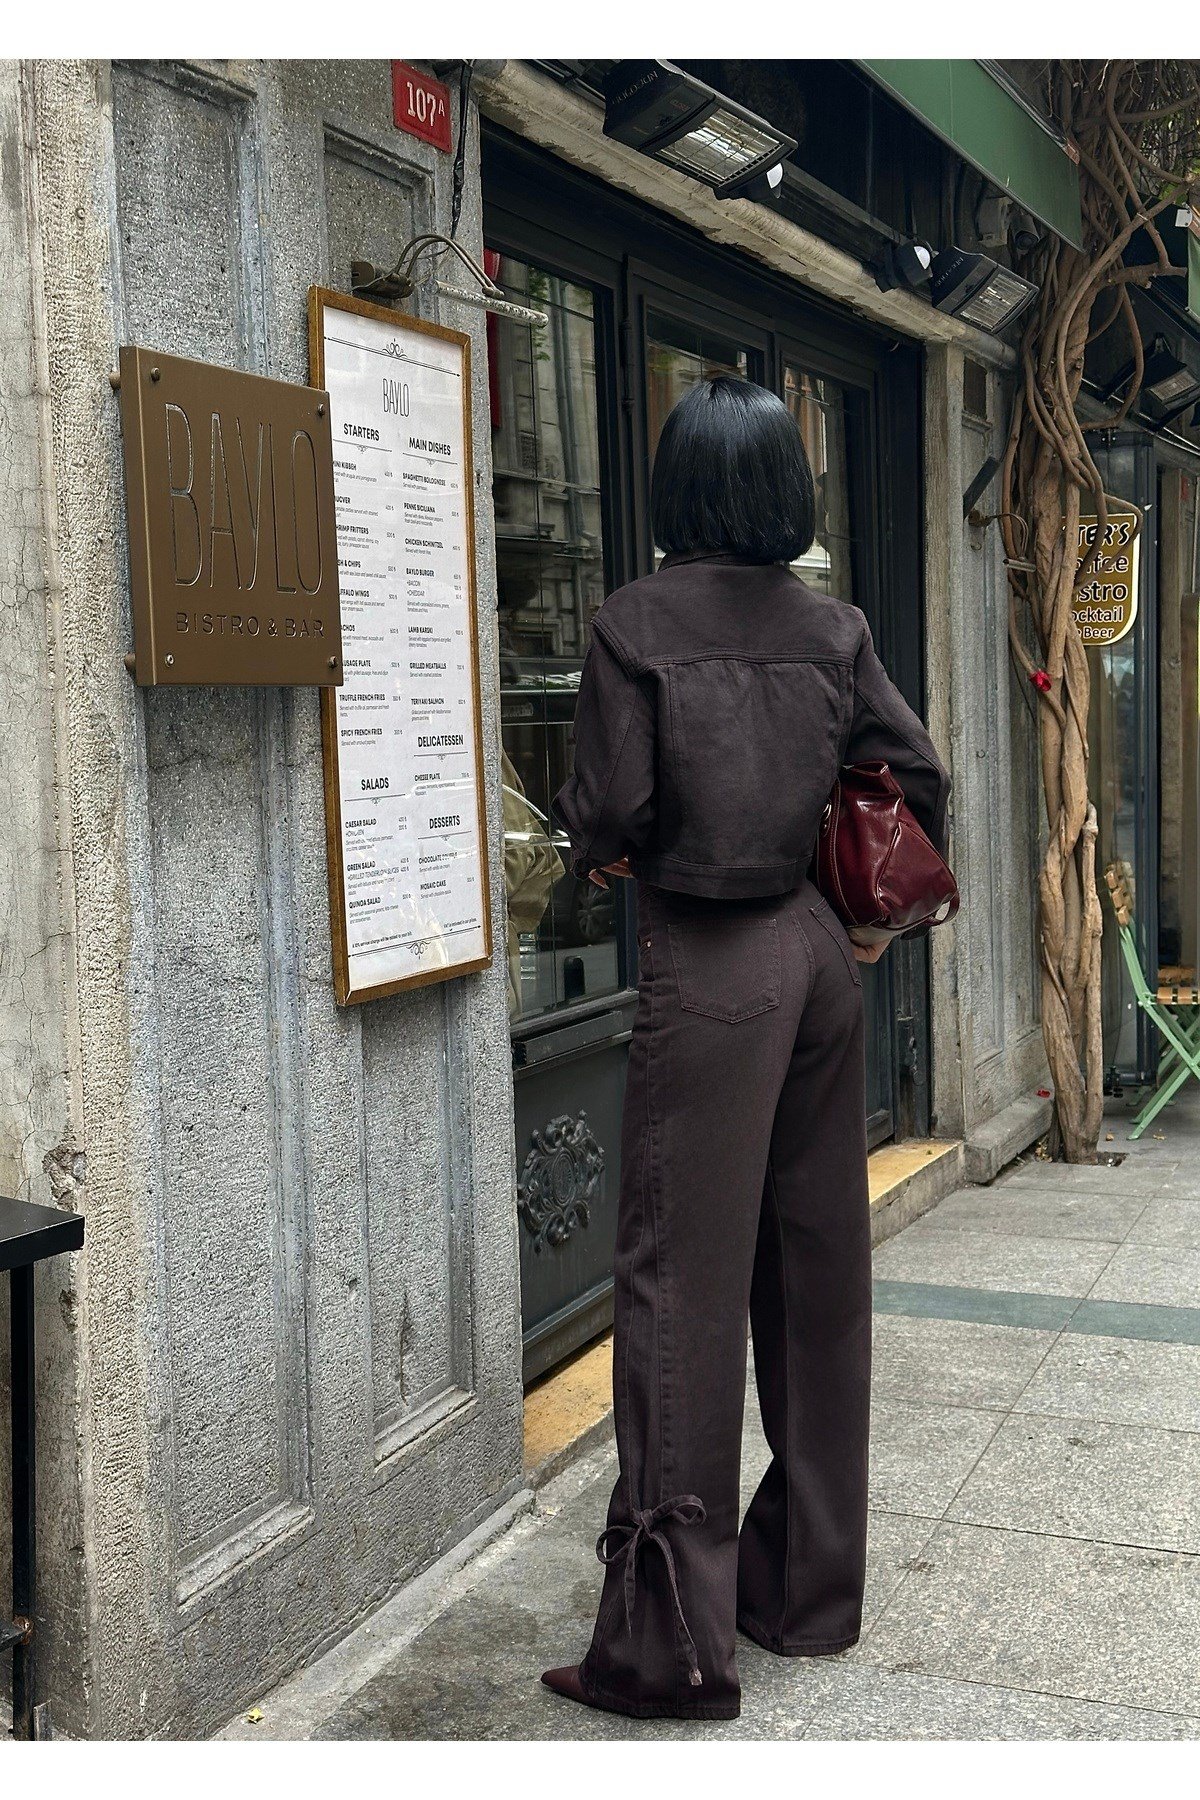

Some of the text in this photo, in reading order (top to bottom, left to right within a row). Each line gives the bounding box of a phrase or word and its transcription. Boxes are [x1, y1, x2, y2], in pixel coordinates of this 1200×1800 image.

[382, 377, 410, 417] BAYLO
[343, 423, 379, 441] STARTERS
[409, 437, 451, 456] MAIN DISHES
[165, 403, 323, 595] BAYLO
[405, 537, 421, 545] CHICKEN
[1078, 581, 1128, 603] stro
[1071, 606, 1124, 622] ocktail
[176, 612, 325, 639] BISTRO & BAR
[418, 734, 463, 747] DELICATESSEN
[429, 772, 440, 780] PLATE
[361, 777, 389, 790] SALADS
[345, 818, 376, 828] CAESAR SALAD
[429, 814, 460, 829] DESSERTS
[347, 860, 375, 871] GREEN SALAD
[418, 854, 441, 864] CHOCOLATE
[420, 879, 445, 890] MOSAIC CAKE
[348, 896, 380, 908] QUINOA SALAD
